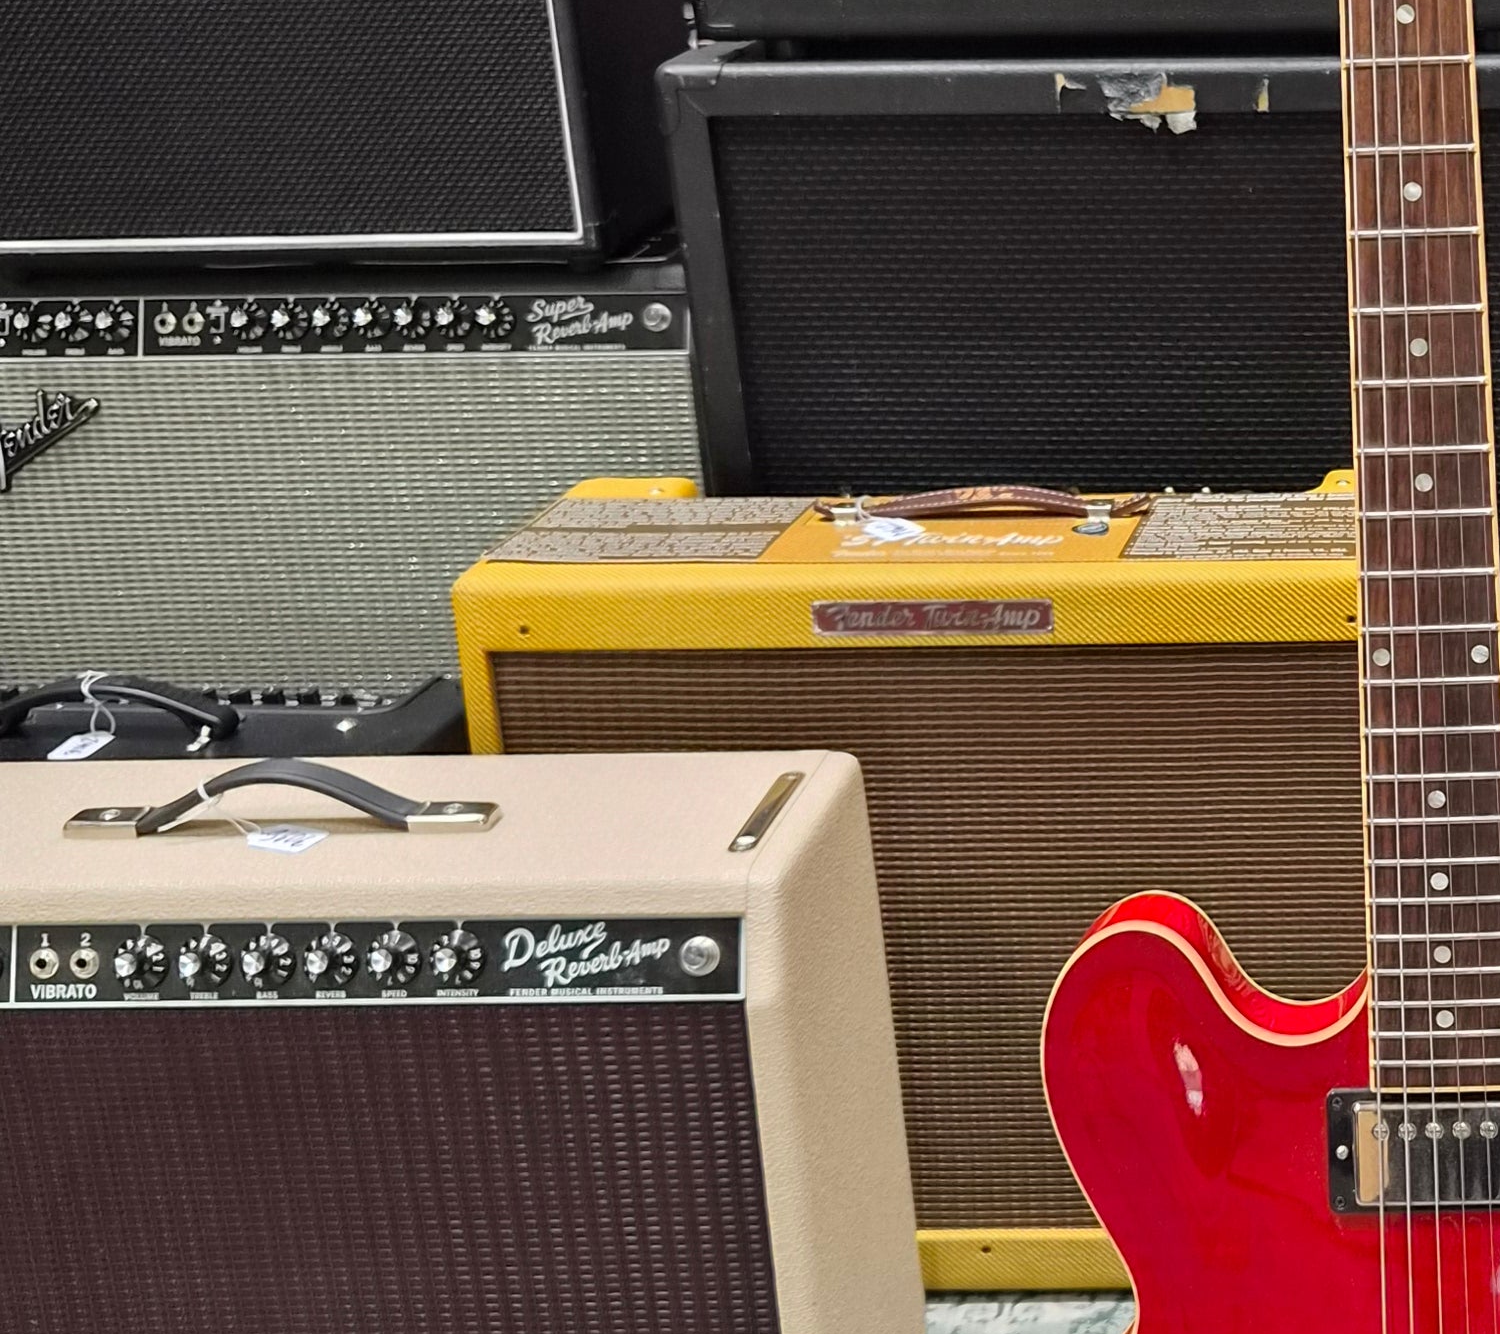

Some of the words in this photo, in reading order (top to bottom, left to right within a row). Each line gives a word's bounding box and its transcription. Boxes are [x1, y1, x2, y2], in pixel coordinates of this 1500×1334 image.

[526, 295, 594, 323] Super
[532, 310, 633, 345] Reverb-Amp
[158, 335, 201, 347] VIBRATO
[826, 604, 916, 631] Fender
[40, 932, 50, 947] 1
[80, 932, 92, 947] 2
[501, 921, 608, 973] Deluxe
[538, 938, 671, 988] Reverb-Amp
[30, 983, 97, 999] VIBRATO
[382, 989, 408, 999] SPEED
[436, 988, 480, 997] INTENSITY
[509, 987, 547, 996] FENDER
[551, 987, 592, 996] MUSICAL
[596, 986, 664, 996] INSTRUMENTS
